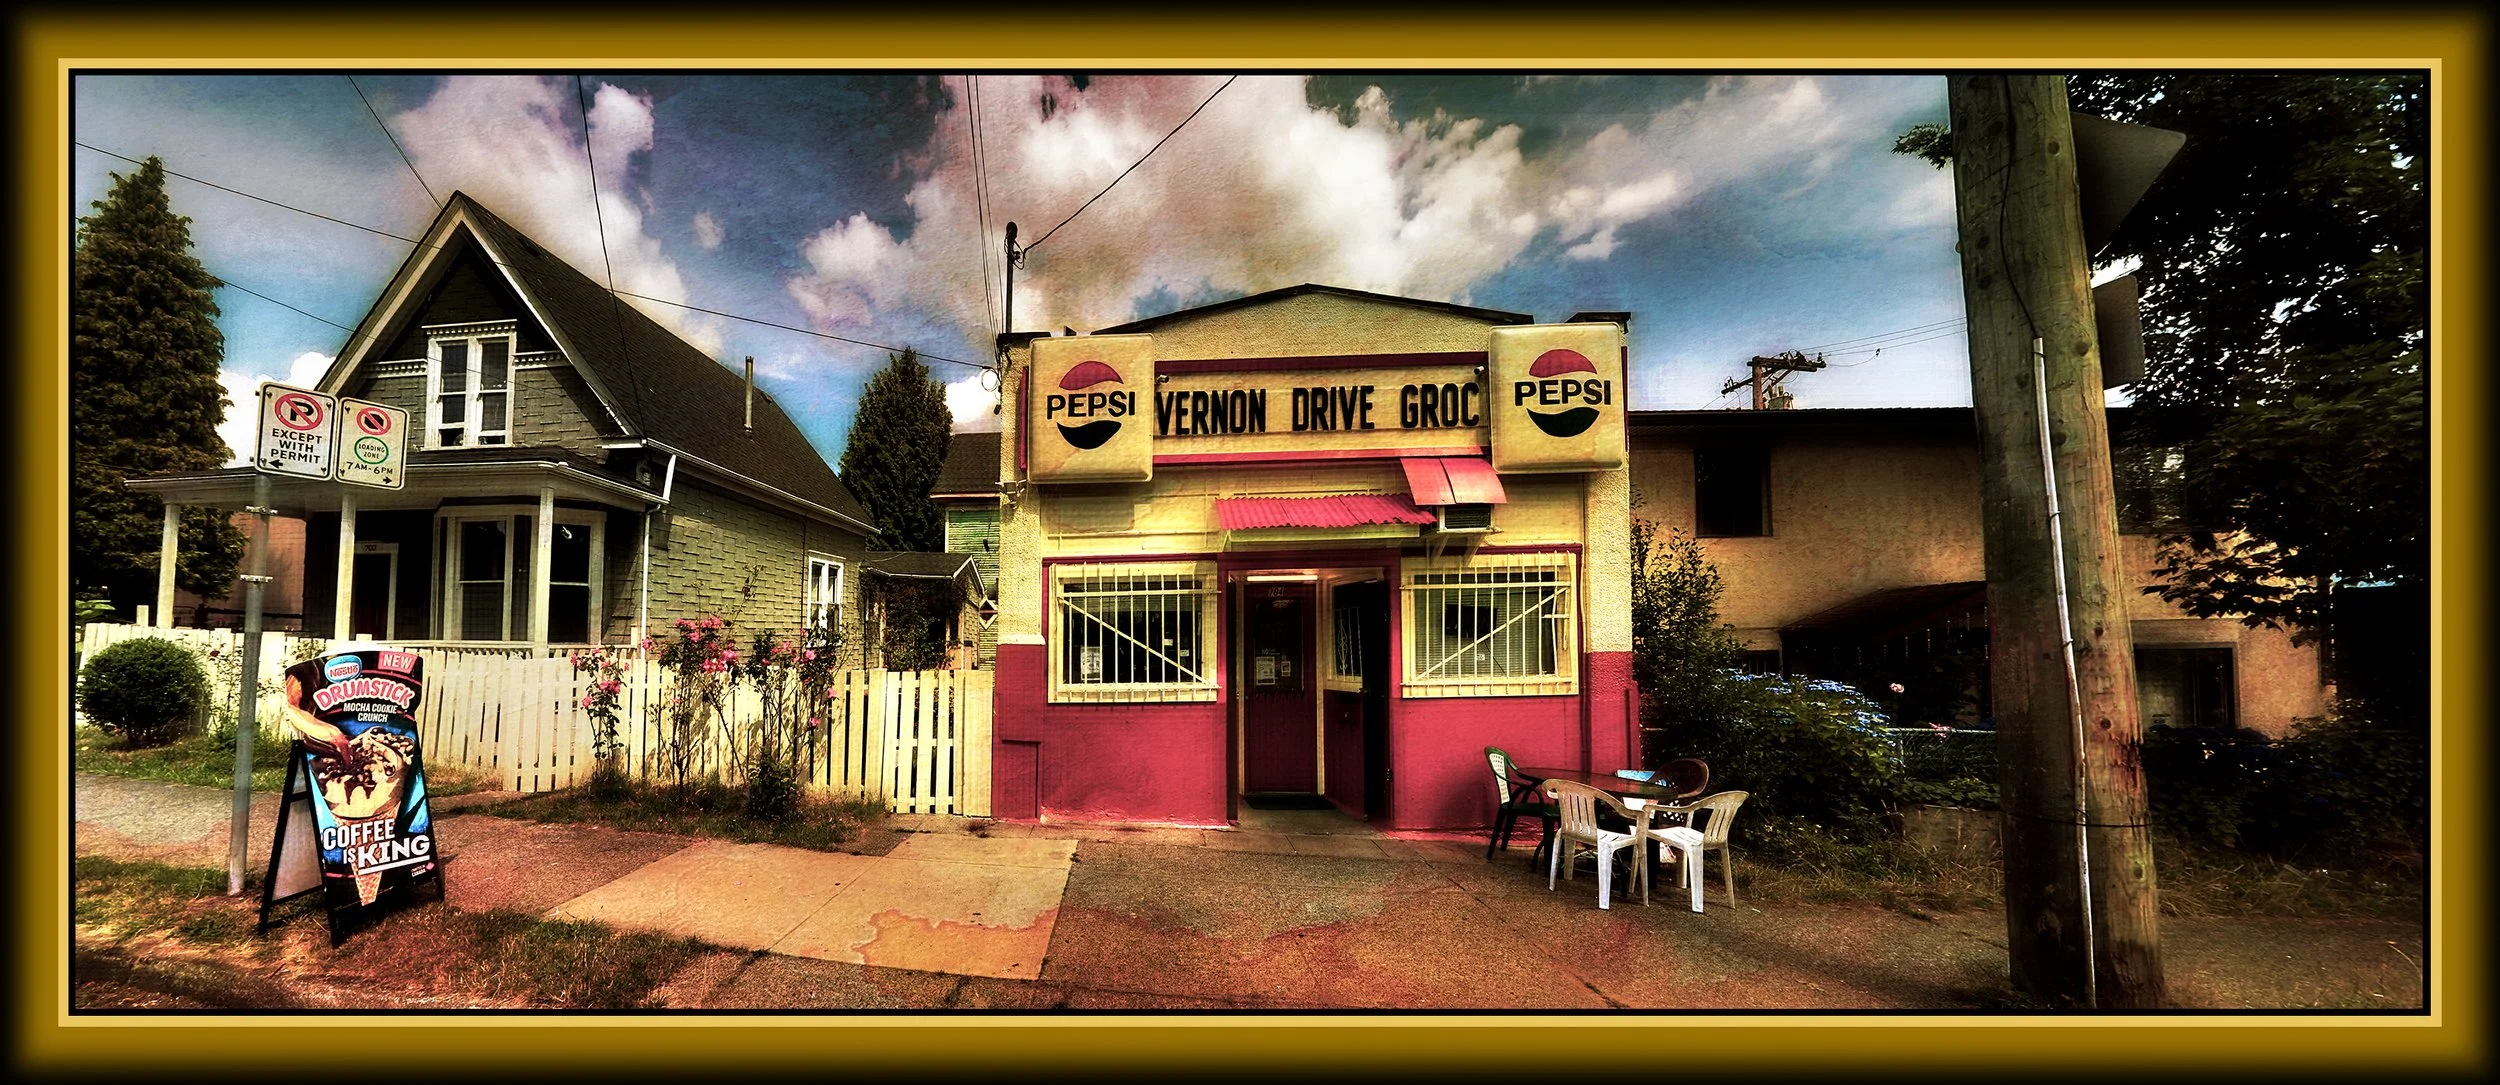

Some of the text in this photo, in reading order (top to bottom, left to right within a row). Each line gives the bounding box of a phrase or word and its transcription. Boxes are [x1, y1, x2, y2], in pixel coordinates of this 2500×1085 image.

[1515, 379, 1612, 406] PEPSI
[1046, 390, 1136, 420] PEPSI
[1156, 382, 1480, 436] VERNON DRIVE GROC
[272, 428, 323, 445] EXCEPT
[278, 439, 314, 453] WITH
[358, 443, 386, 453] LOADING
[270, 448, 321, 464] PERMIT
[363, 451, 380, 459] ZONE
[383, 654, 413, 669] NEW
[313, 678, 415, 711] DRUMSTICK
[343, 702, 399, 714] MOCHA COOKIE
[357, 712, 389, 723] CRUNCH
[323, 818, 396, 851] COFFEE
[343, 834, 431, 868] IS KING
